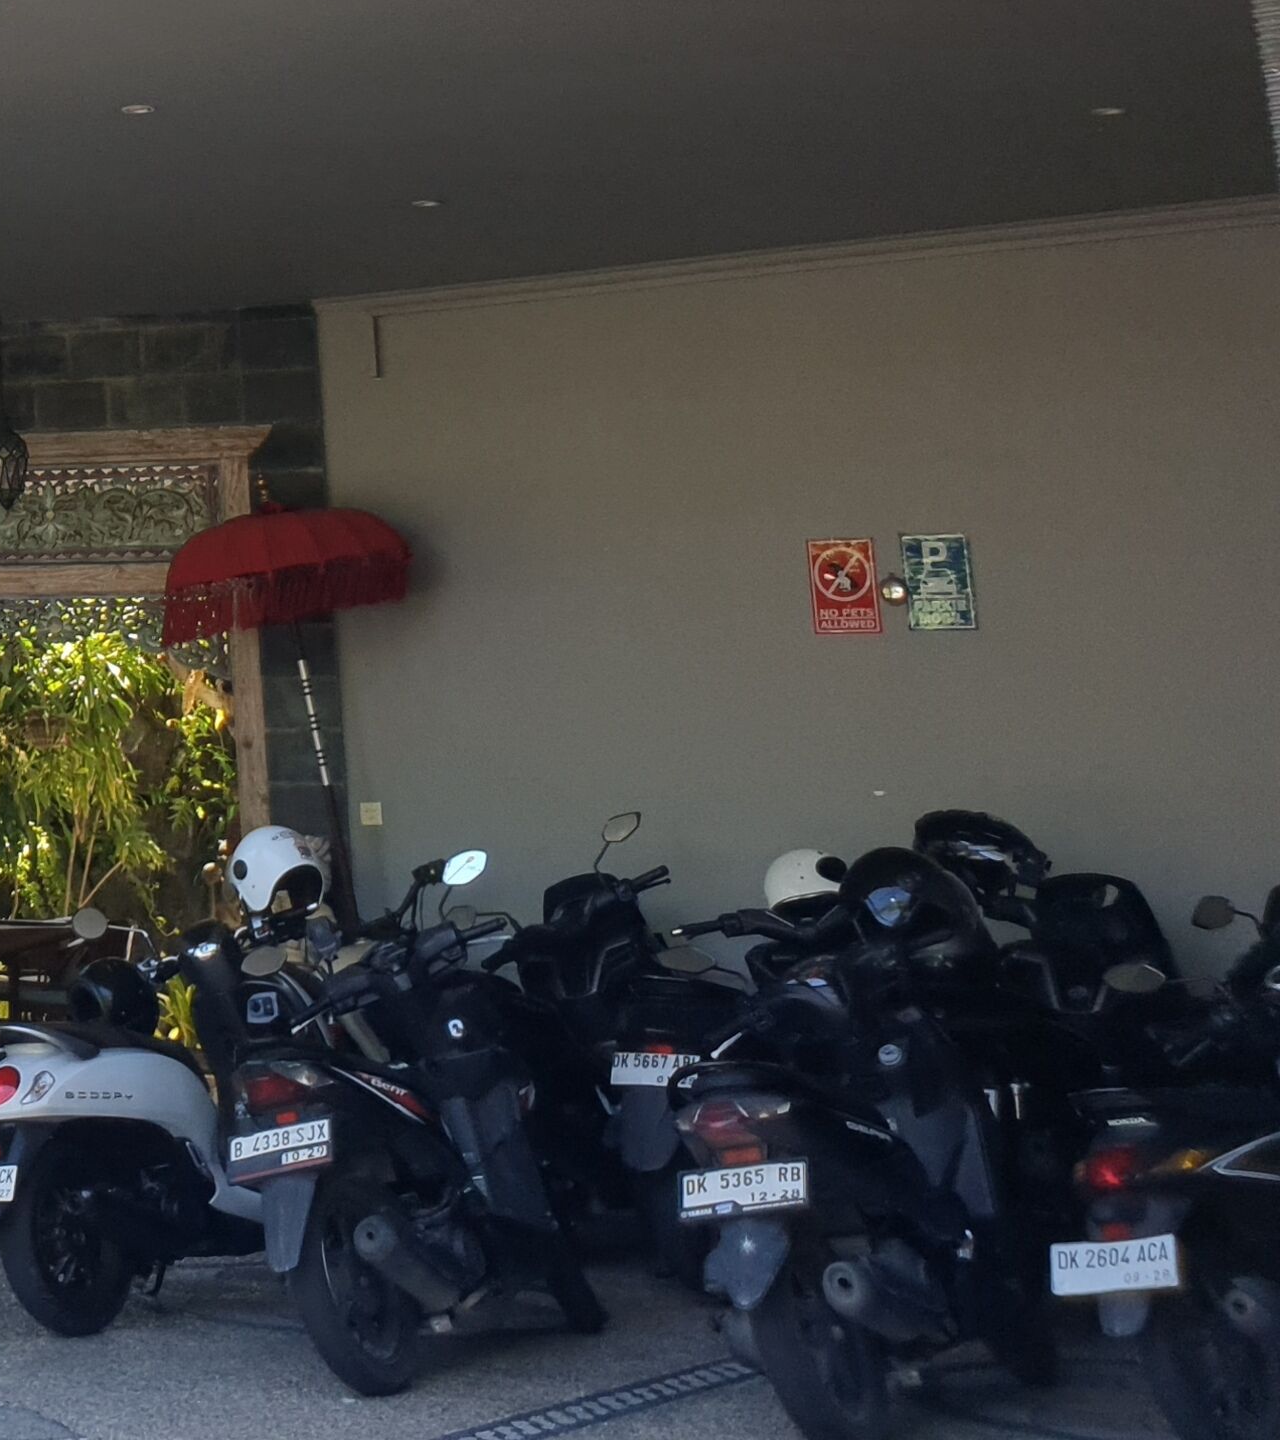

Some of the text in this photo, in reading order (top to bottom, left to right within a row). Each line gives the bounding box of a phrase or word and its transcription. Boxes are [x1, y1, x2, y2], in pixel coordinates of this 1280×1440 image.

[819, 607, 875, 618] NO PETS
[820, 619, 875, 630] ALLOWED
[612, 1053, 629, 1068] DK
[633, 1054, 669, 1069] 5667
[65, 1091, 134, 1101] SCOOPY
[233, 1122, 327, 1159] B 4338 SJX
[686, 1166, 801, 1196] DK 5365 RB
[1058, 1241, 1170, 1270] DK 2604 ACA
